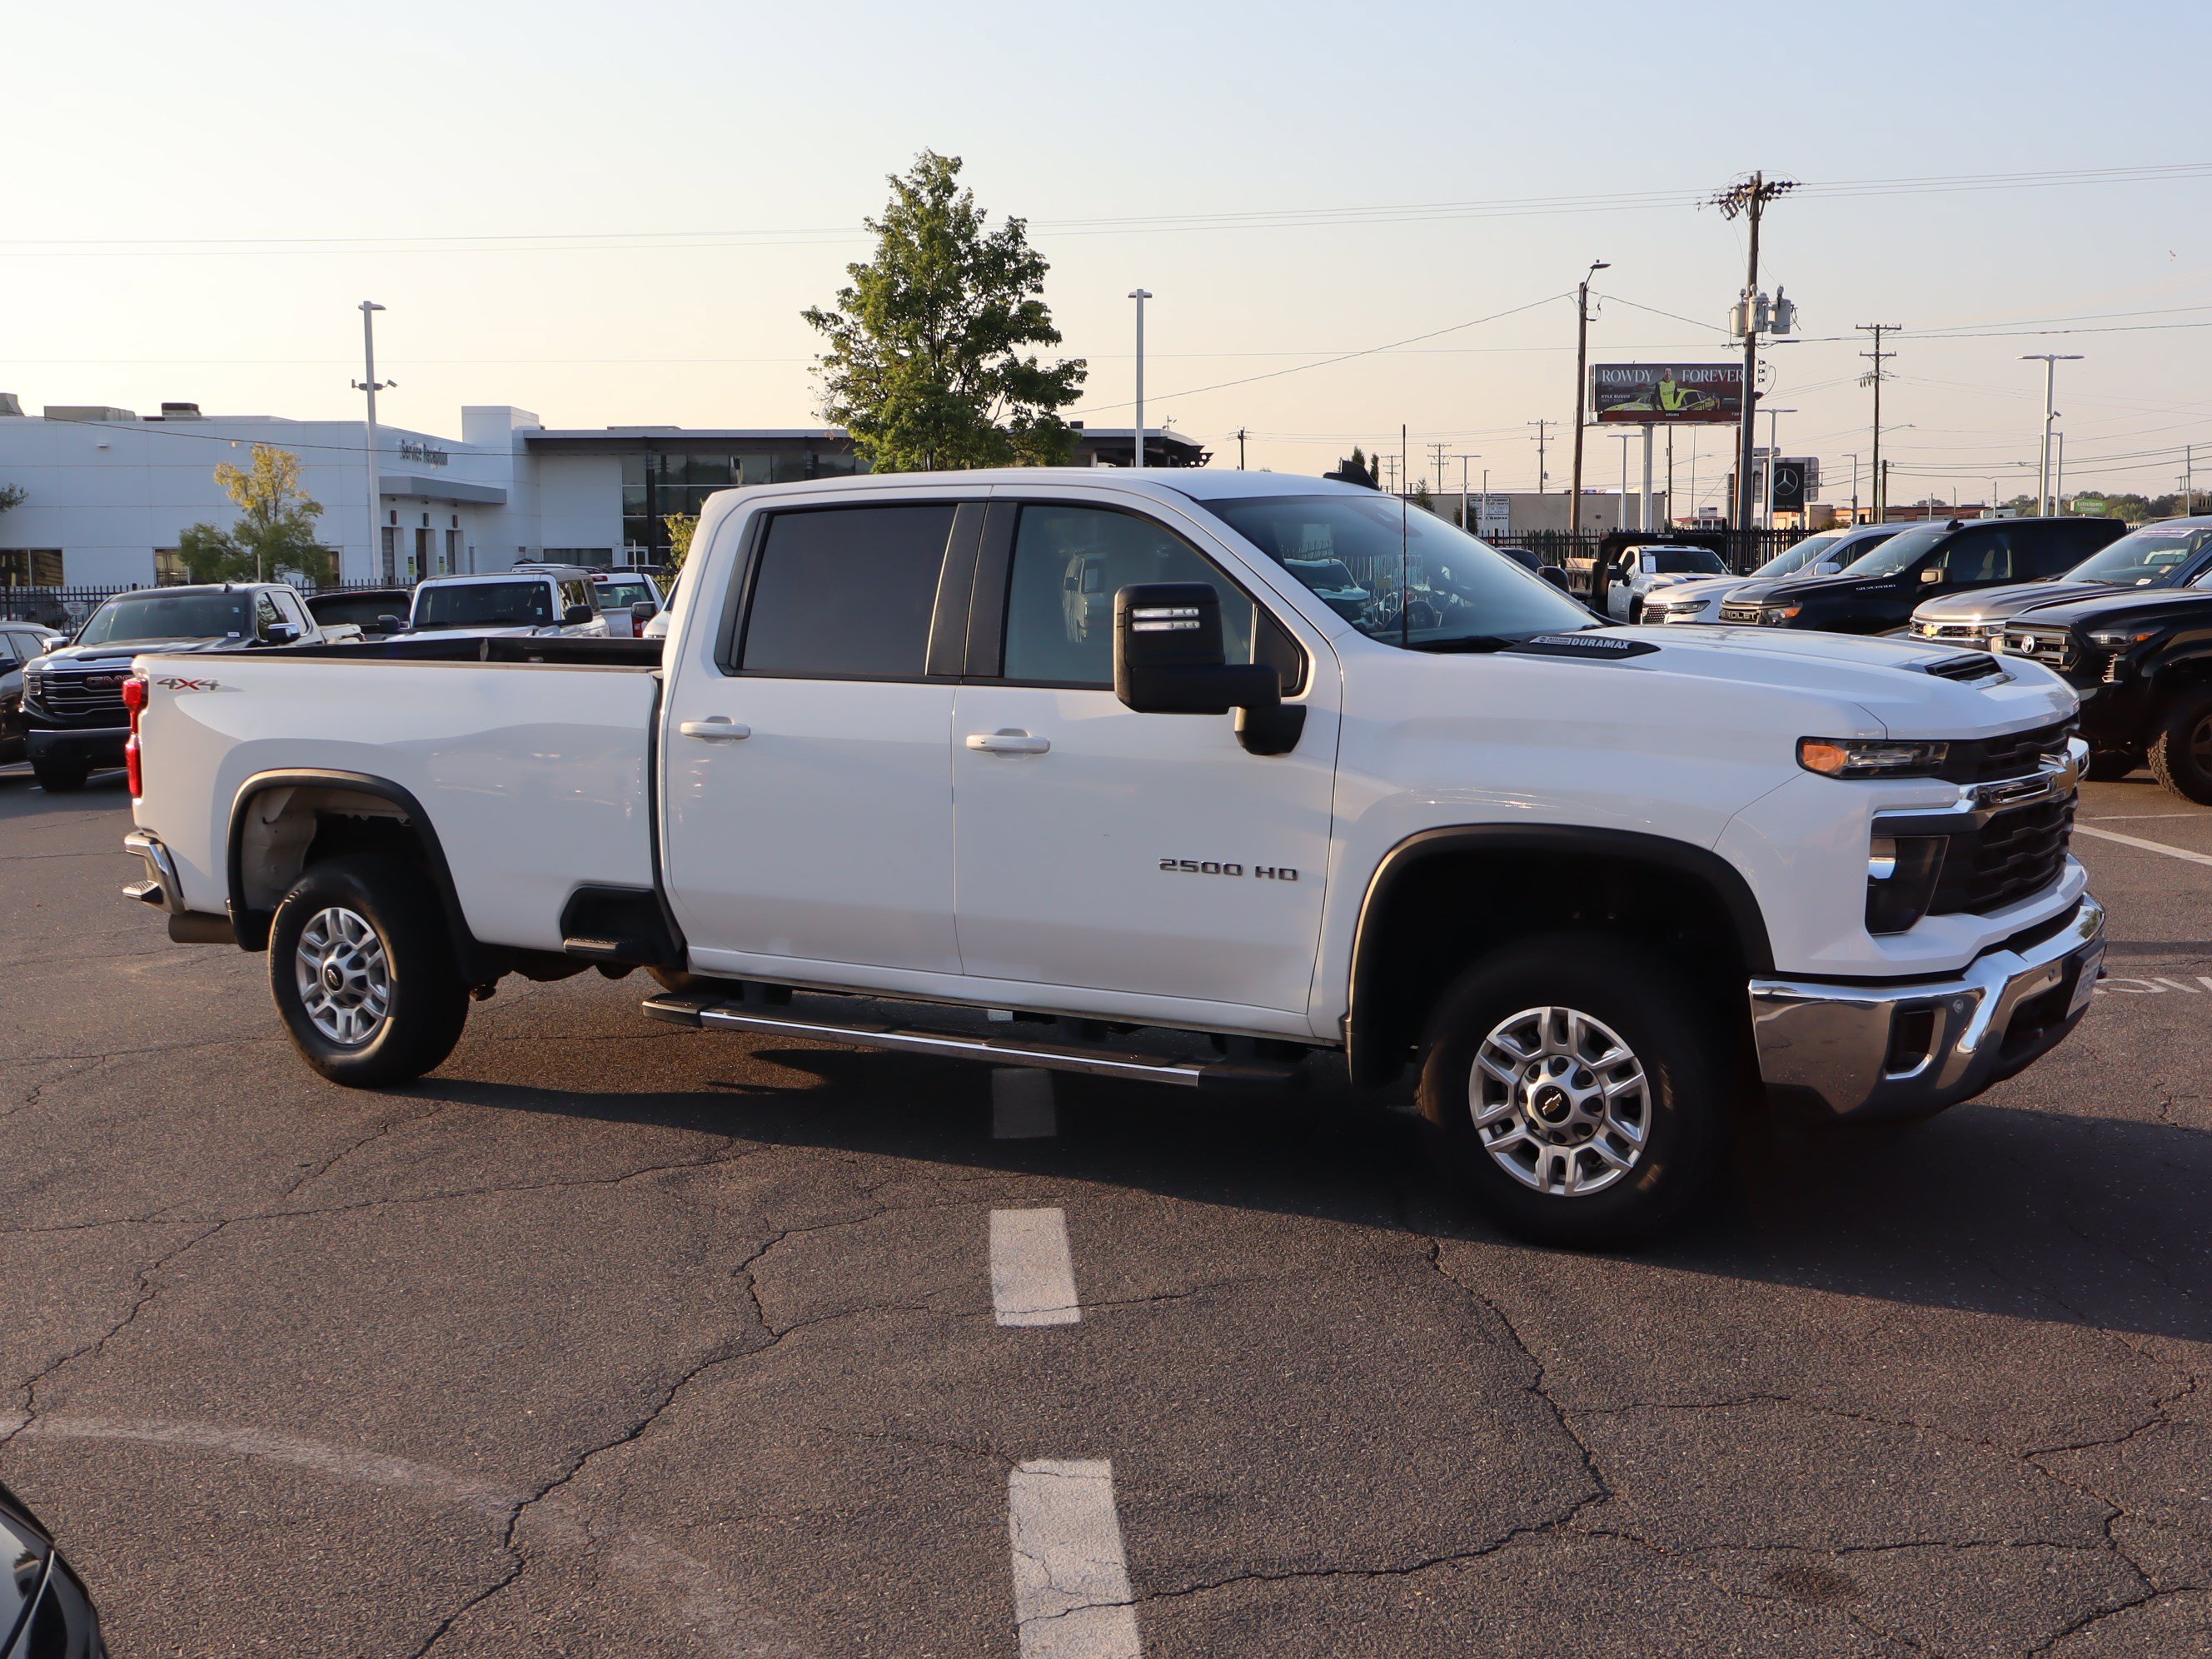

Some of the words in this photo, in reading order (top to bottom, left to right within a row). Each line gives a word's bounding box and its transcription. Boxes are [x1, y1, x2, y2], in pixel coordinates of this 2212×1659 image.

[1602, 369, 1653, 382] ROWDY
[1682, 369, 1743, 382] FOREVER
[1571, 638, 1631, 650] DURAMAX
[1158, 859, 1243, 876] 2500
[1255, 865, 1299, 881] HD
